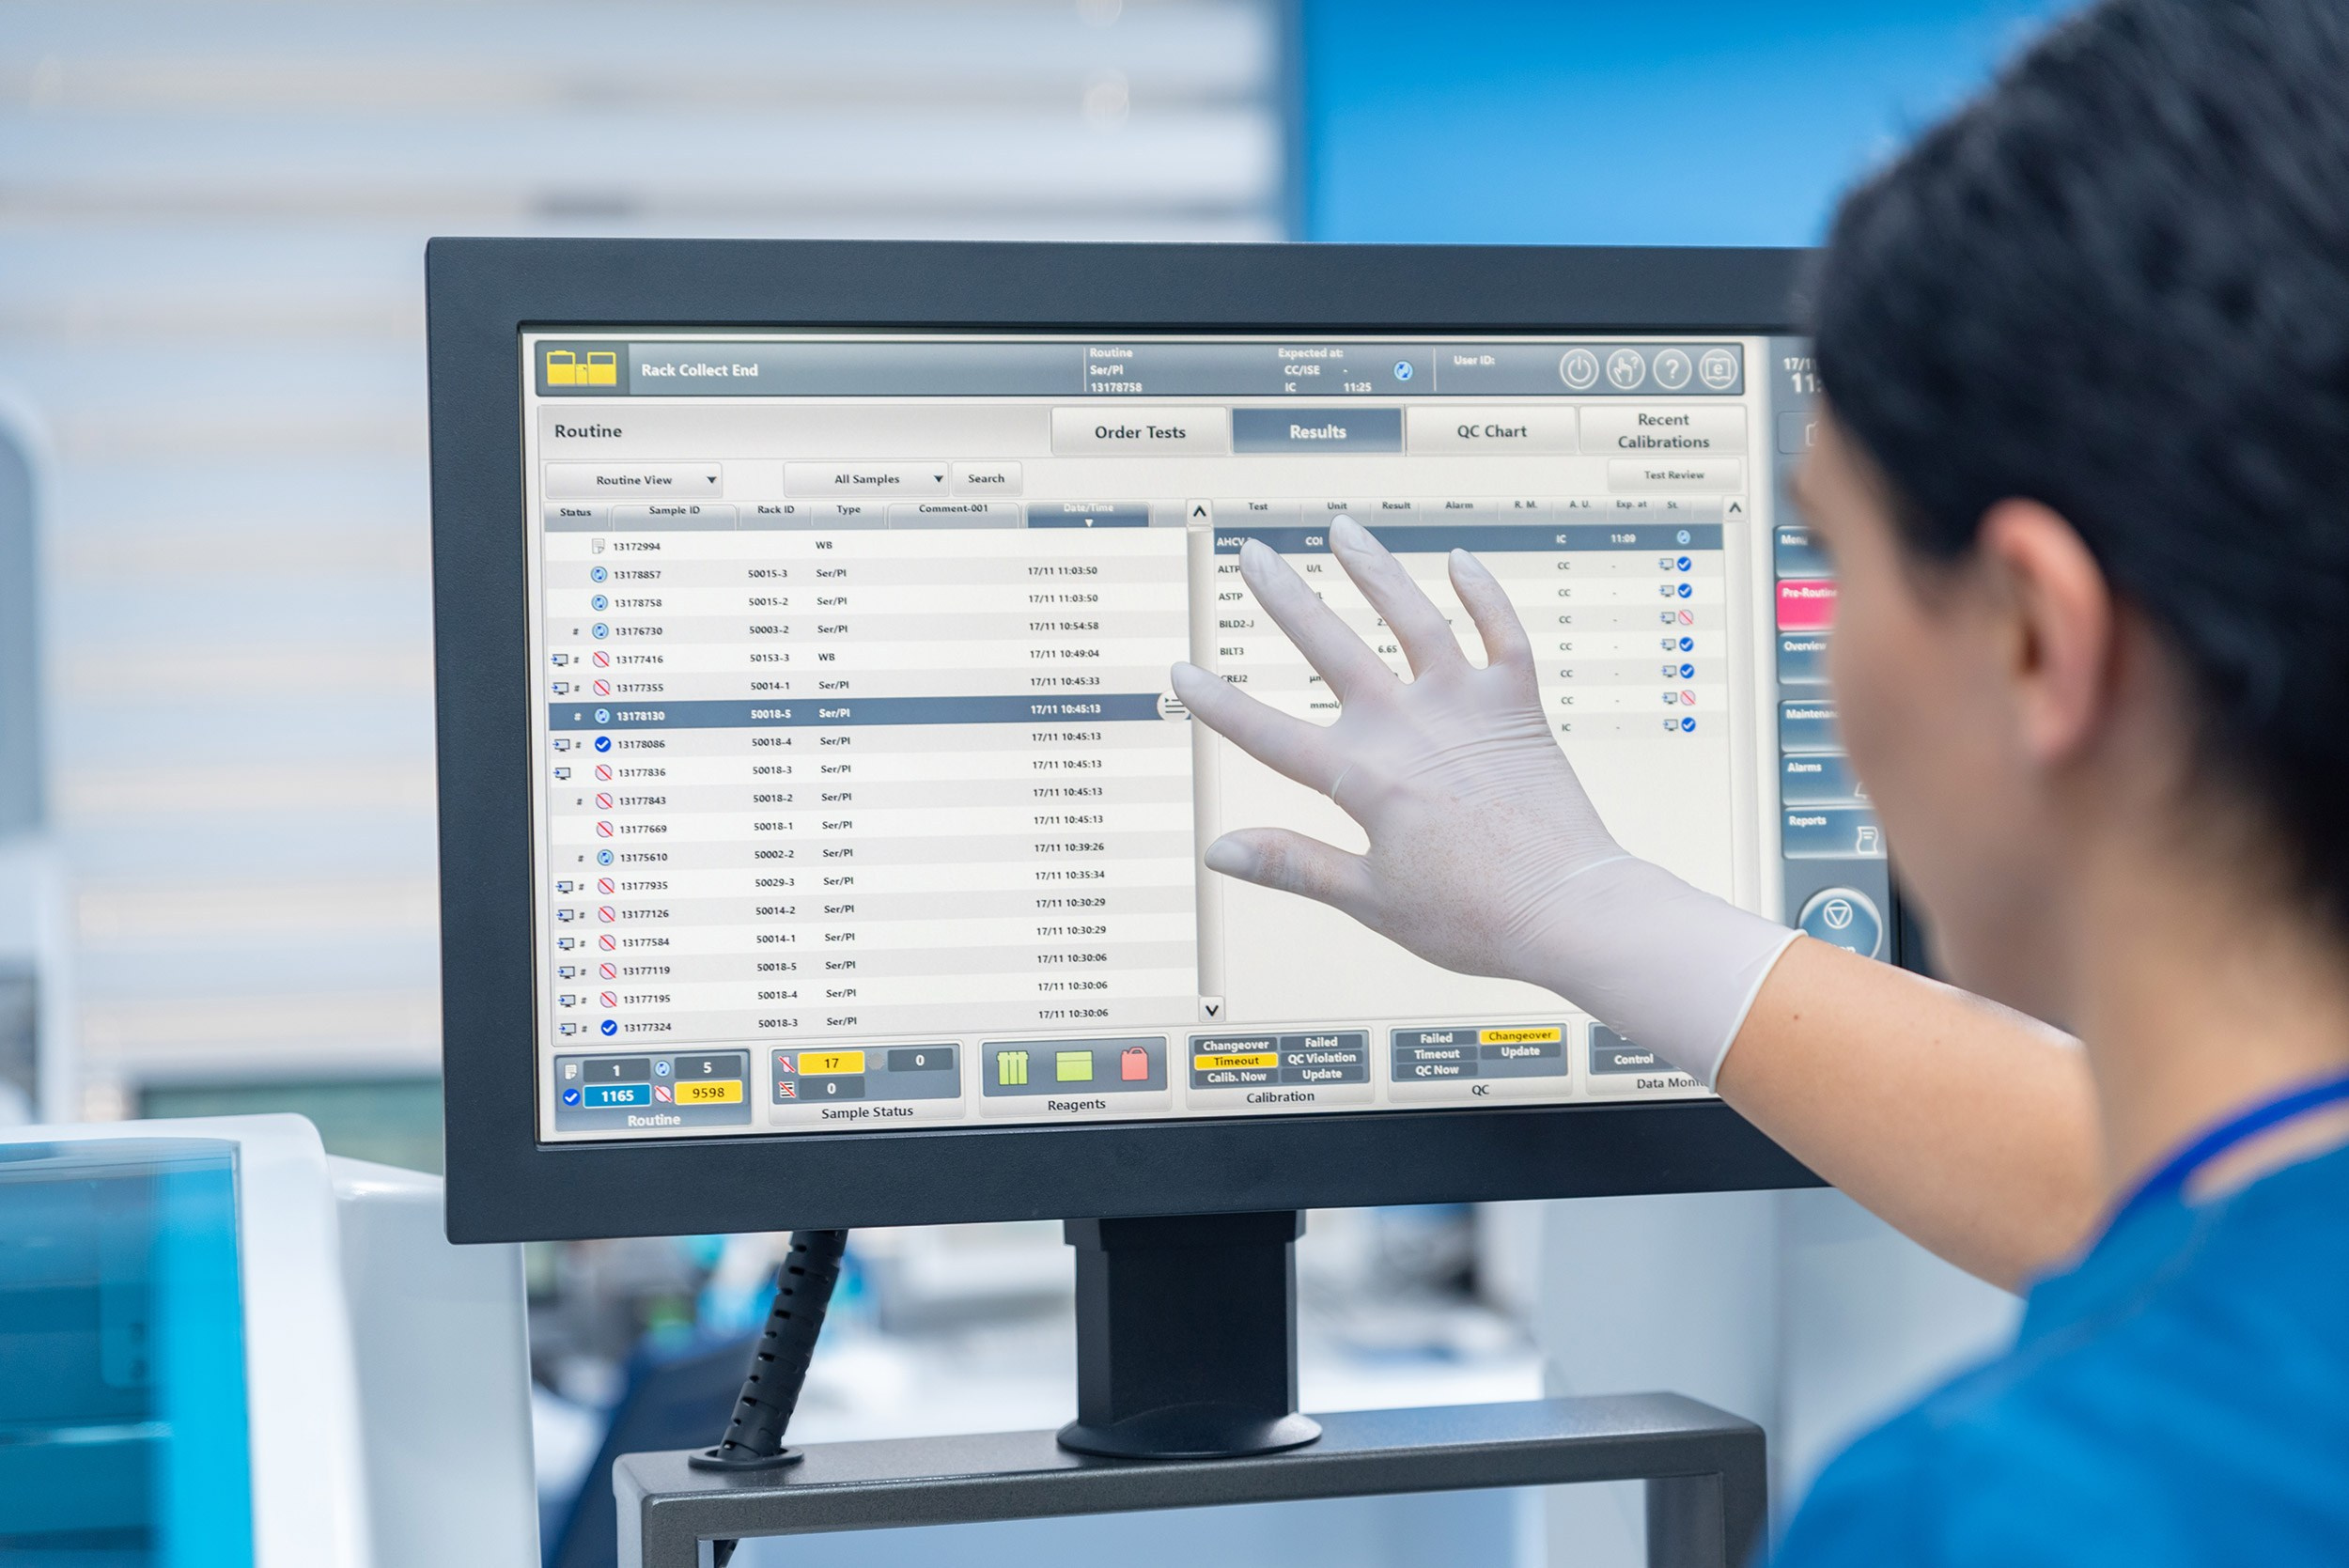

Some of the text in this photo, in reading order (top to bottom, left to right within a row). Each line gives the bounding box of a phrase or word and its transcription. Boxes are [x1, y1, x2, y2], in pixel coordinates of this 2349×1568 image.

[1089, 347, 1134, 358] Routine
[1278, 347, 1344, 361] Expected at:
[1454, 355, 1495, 365] User ID:
[641, 363, 758, 377] Rack Collect End
[1283, 365, 1320, 377] CC/ISE
[1090, 381, 1143, 393] 13178758
[1284, 381, 1297, 393] IC
[1344, 381, 1372, 393] 11:25
[1638, 412, 1689, 427] Recent
[554, 423, 623, 439] Routine
[1095, 425, 1187, 440] Order Tests
[1290, 424, 1347, 440] Results
[1456, 424, 1528, 440] QC Chart
[1618, 435, 1710, 449] Calibrations
[596, 474, 673, 486] Routine View
[968, 473, 1005, 484] Search
[1644, 470, 1704, 480] Test Review
[834, 474, 900, 487] All Samples
[757, 505, 795, 514] Rack ID
[918, 504, 988, 513] Comment-001
[1063, 503, 1114, 512] Date/Time
[1249, 502, 1268, 511] Test
[1327, 502, 1347, 510] Unit
[1382, 501, 1411, 510] Result
[1445, 501, 1474, 510] Alarm
[1514, 500, 1537, 509] R. M.
[1569, 500, 1591, 509] A. U.
[1616, 500, 1635, 509] Exp.
[560, 507, 592, 517] Status
[648, 505, 701, 517] Sample ID
[836, 505, 862, 516] Type
[1305, 536, 1324, 546] COI
[1556, 534, 1567, 544] IC
[1610, 534, 1637, 543] 11:09
[613, 542, 661, 551] 13172994
[815, 540, 833, 550] WB
[1058, 566, 1098, 575] 11:03:50
[1306, 564, 1323, 573] U/L
[1557, 561, 1570, 570] CC
[614, 570, 661, 580] 13178857
[748, 568, 788, 579] 50015-3
[1218, 592, 1244, 601] ASTP
[1557, 588, 1571, 598] CC
[614, 598, 662, 608] 13178758
[748, 597, 788, 607] 50015-2
[1058, 594, 1099, 603] 11:03:50
[1219, 619, 1254, 629] BILD2-J
[1558, 615, 1572, 625] CC
[749, 625, 789, 635] 50003-2
[1059, 621, 1099, 630] 10:54:58
[615, 627, 663, 636] 13176730
[1220, 646, 1245, 656] BILT3
[1377, 645, 1397, 654] 6.65
[1559, 642, 1573, 651] CC
[1783, 642, 1827, 651] Overview
[750, 653, 790, 663] 50153-3
[817, 652, 835, 661] WB
[1060, 649, 1100, 659] 10:49:04
[615, 655, 664, 664] 13177416
[1560, 669, 1573, 678] CC
[750, 681, 790, 691] 50014-1
[1061, 676, 1100, 686] 10:45:33
[616, 683, 664, 692] 13177355
[1560, 696, 1574, 706] CC
[751, 708, 792, 720] 50018-5
[1060, 704, 1101, 714] 10:45:13
[616, 710, 665, 722] 13178130
[1561, 722, 1571, 732] IC
[1062, 731, 1102, 741] 10:45:13
[617, 739, 666, 750] 13178086
[752, 737, 792, 747] 50018-4
[1063, 759, 1102, 768] 10:45:13
[1787, 763, 1822, 772] Alarms
[618, 768, 666, 778] 13177836
[753, 765, 793, 775] 50018-3
[1063, 786, 1103, 797] 10:45:13
[618, 796, 667, 806] 13177843
[753, 793, 793, 803] 50018-2
[1064, 815, 1104, 824] 10:45:13
[1789, 815, 1827, 826] Reports
[619, 824, 668, 834] 13177669
[754, 821, 793, 831] 50018-1
[1065, 842, 1105, 852] 10:39:26
[620, 852, 668, 862] 13175610
[754, 849, 795, 860] 50002-2
[1065, 870, 1105, 879] 10:35:34
[621, 880, 669, 891] 13177935
[754, 877, 795, 888] 50029-3
[1066, 897, 1106, 908] 10:30:29
[621, 908, 670, 920] 13177126
[755, 906, 796, 916] 50014-2
[1066, 925, 1107, 935] 10:30:29
[622, 938, 670, 948] 13177584
[756, 934, 796, 944] 50014-1
[1066, 953, 1108, 963] 10:30:06
[622, 966, 671, 976] 13177119
[756, 962, 797, 972] 50018-5
[1067, 980, 1109, 990] 10:30:06
[623, 994, 671, 1004] 13177195
[757, 990, 798, 1001] 50018-4
[1068, 1008, 1109, 1018] 10:30:06
[624, 1022, 672, 1032] 13177324
[758, 1018, 799, 1029] 50018-3
[1420, 1033, 1454, 1044] Failed
[1489, 1031, 1552, 1042] Changeover
[1203, 1039, 1269, 1053] Changeover
[1305, 1037, 1338, 1048] Failed
[1413, 1048, 1461, 1060] Timeout
[1501, 1046, 1541, 1058] Update
[824, 1057, 840, 1069] 17
[1213, 1056, 1260, 1067] Timeout
[1287, 1053, 1357, 1065] QC Violation
[1613, 1052, 1655, 1065] Control
[612, 1064, 620, 1077] 1
[703, 1061, 712, 1074] 5
[1415, 1064, 1460, 1077] QC Now
[1207, 1071, 1268, 1082] Calib. Now
[1302, 1068, 1343, 1082] Update
[1637, 1079, 1665, 1090] Data
[692, 1087, 725, 1099] 9598
[1471, 1084, 1490, 1097] QC
[600, 1089, 635, 1103] 1165
[1246, 1091, 1315, 1104] Calibration
[1048, 1098, 1107, 1113] Reagents
[821, 1106, 914, 1122] Sample Status
[628, 1115, 681, 1128] Routine
